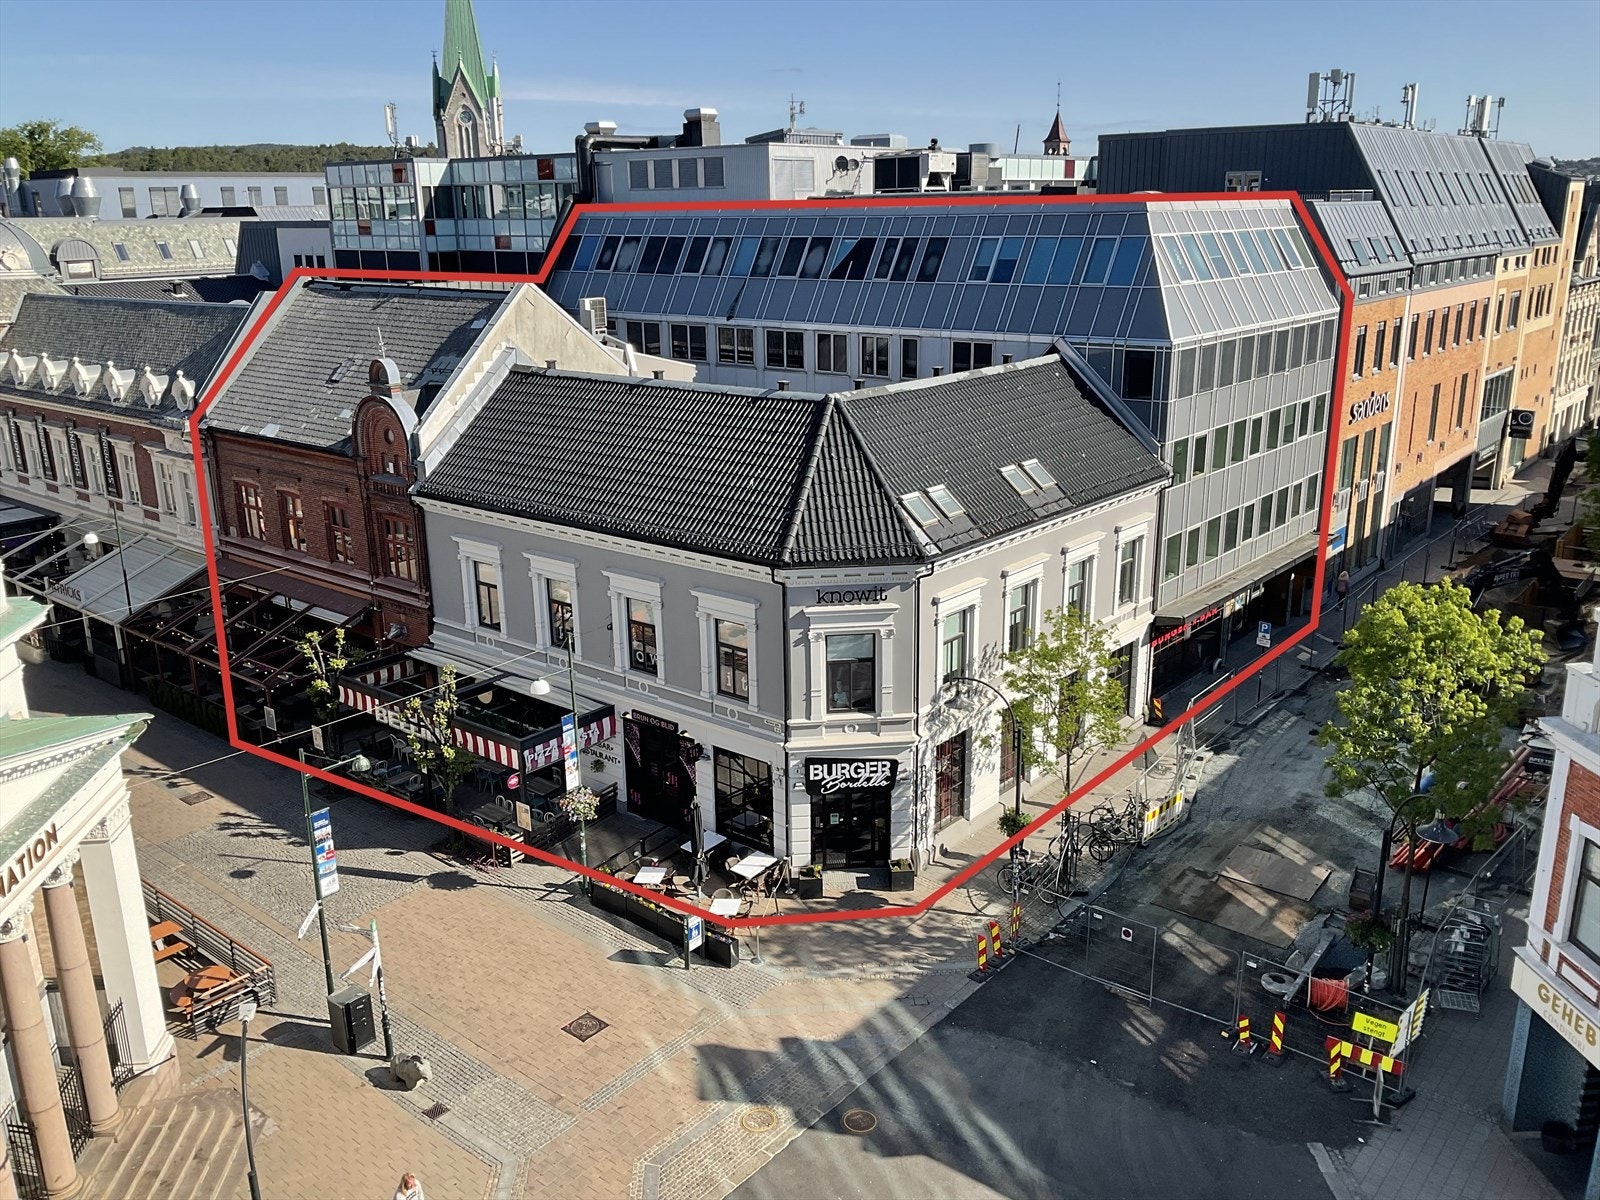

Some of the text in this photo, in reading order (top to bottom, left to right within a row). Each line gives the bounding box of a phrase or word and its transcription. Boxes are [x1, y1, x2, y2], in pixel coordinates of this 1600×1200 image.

[1352, 391, 1390, 423] sandens
[68, 427, 81, 477] SHOPPING
[100, 431, 113, 484] SHOPPING
[816, 586, 888, 604] knowit
[1261, 623, 1269, 633] P
[633, 711, 675, 732] BRUN OG BLID
[528, 744, 558, 763] PIZZA
[809, 761, 891, 781] BURGER
[820, 771, 891, 794] Bordello
[1365, 1017, 1387, 1030] Vegen
[1537, 983, 1597, 1047] GEHEB
[1363, 1026, 1386, 1037] stengt
